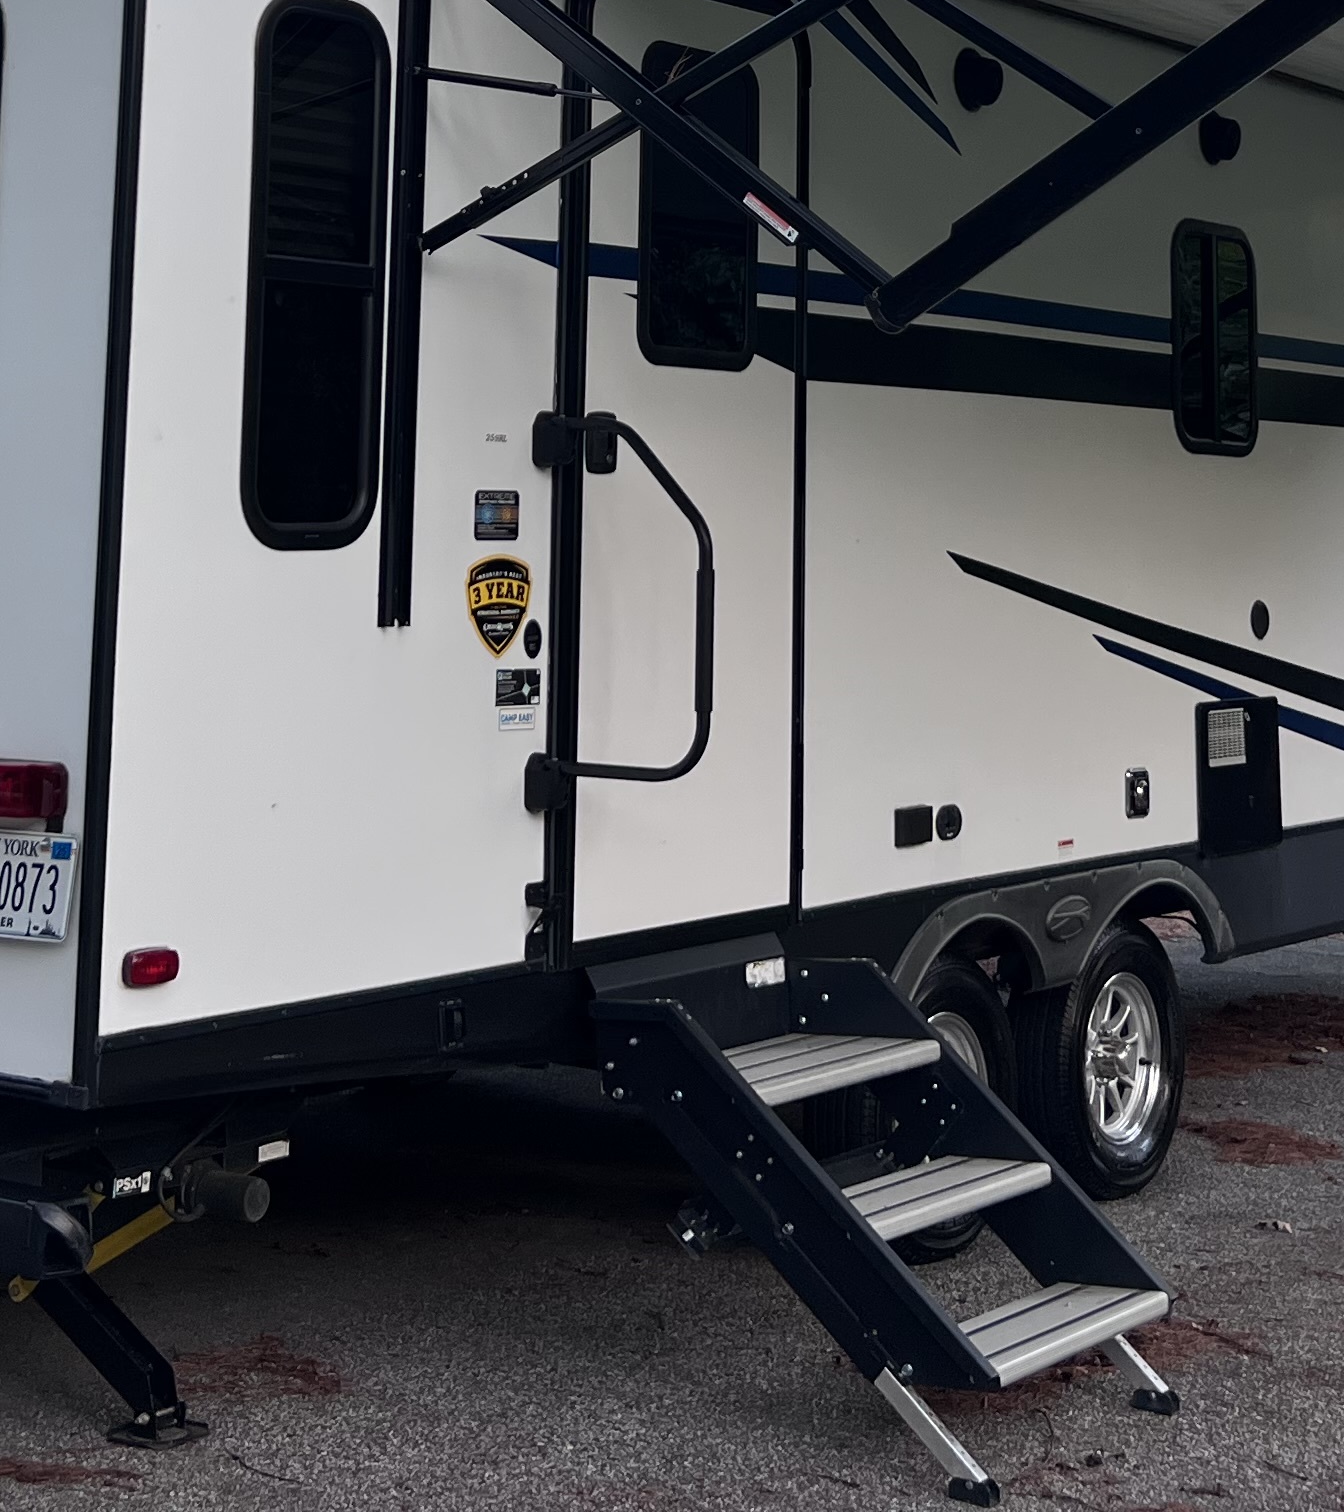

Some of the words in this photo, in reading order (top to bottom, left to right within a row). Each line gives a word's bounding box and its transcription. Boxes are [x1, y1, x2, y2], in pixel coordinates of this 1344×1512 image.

[472, 586, 482, 605] 3
[485, 581, 525, 603] YEAR
[3, 838, 40, 858] YORK
